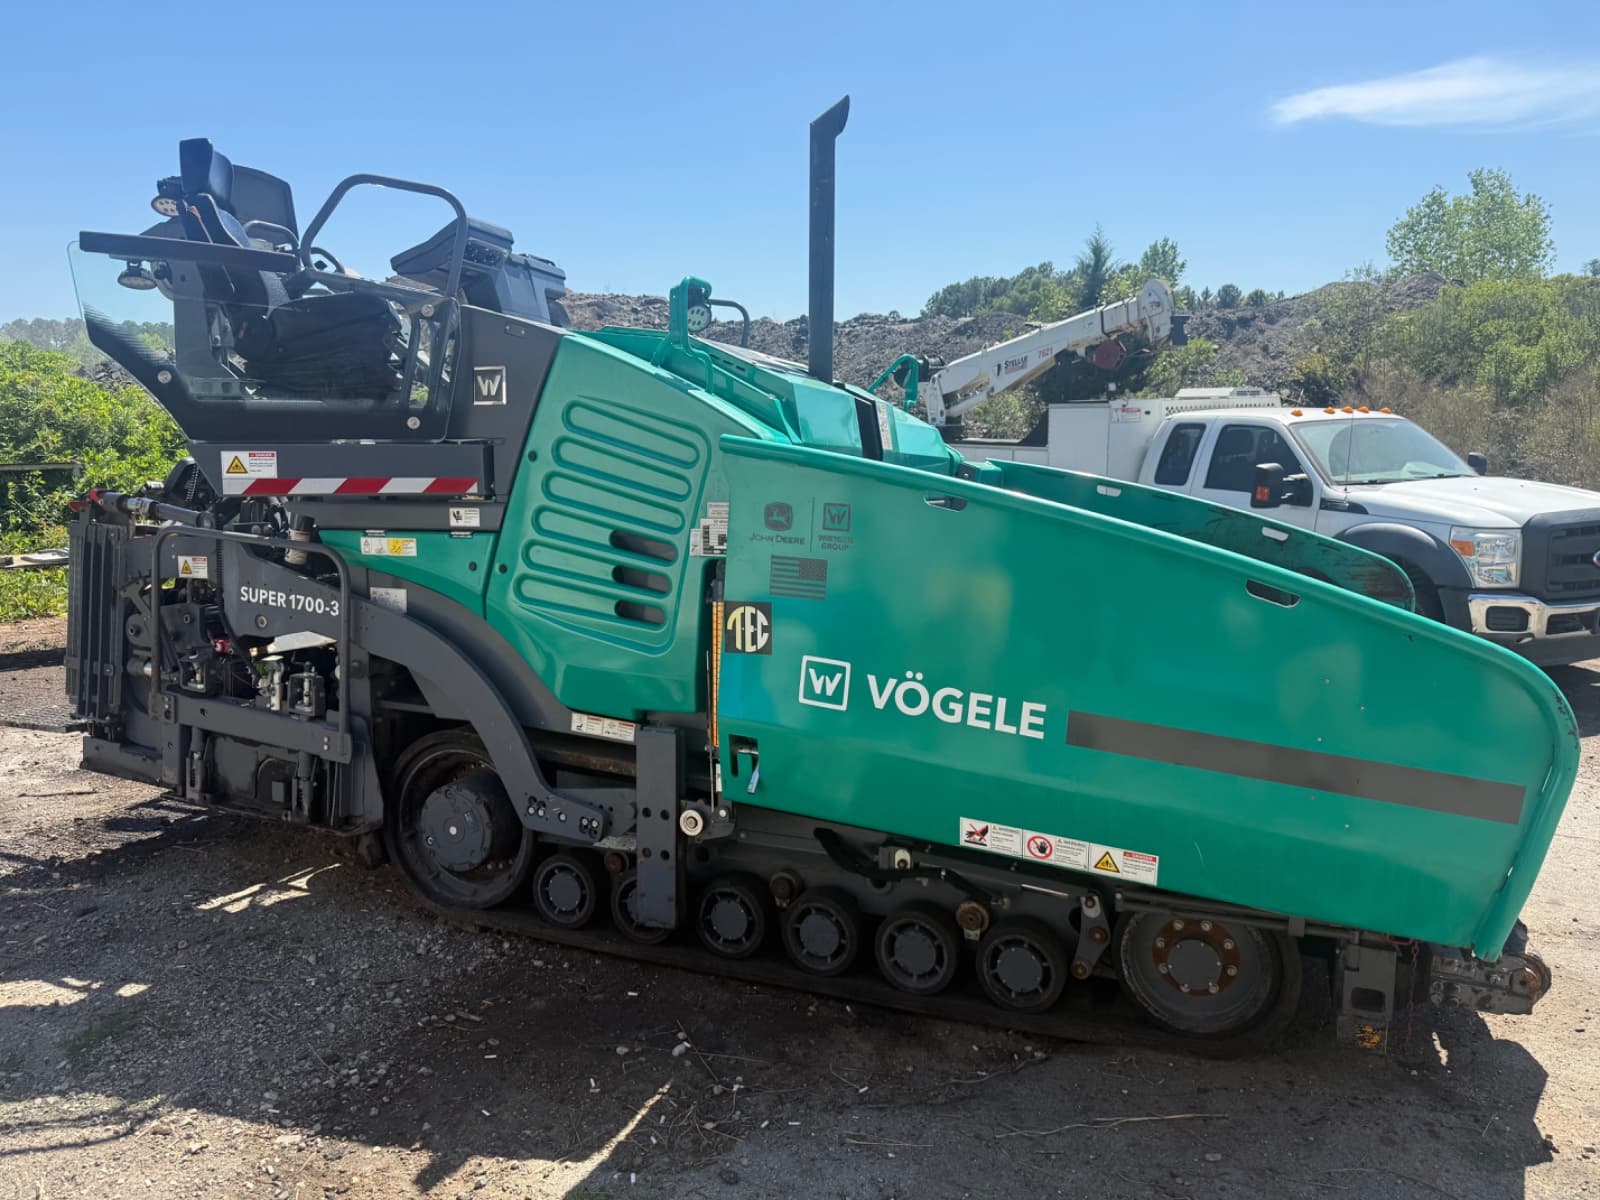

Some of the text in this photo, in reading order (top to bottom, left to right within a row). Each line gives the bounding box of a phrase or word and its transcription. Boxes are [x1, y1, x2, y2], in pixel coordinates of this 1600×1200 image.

[476, 374, 502, 396] W
[750, 531, 806, 545] JOHN DEERE
[821, 543, 849, 551] GROUP
[240, 586, 340, 616] SUPER 1700-3
[727, 605, 769, 653] TEC
[866, 670, 1047, 740] VÖGELE
